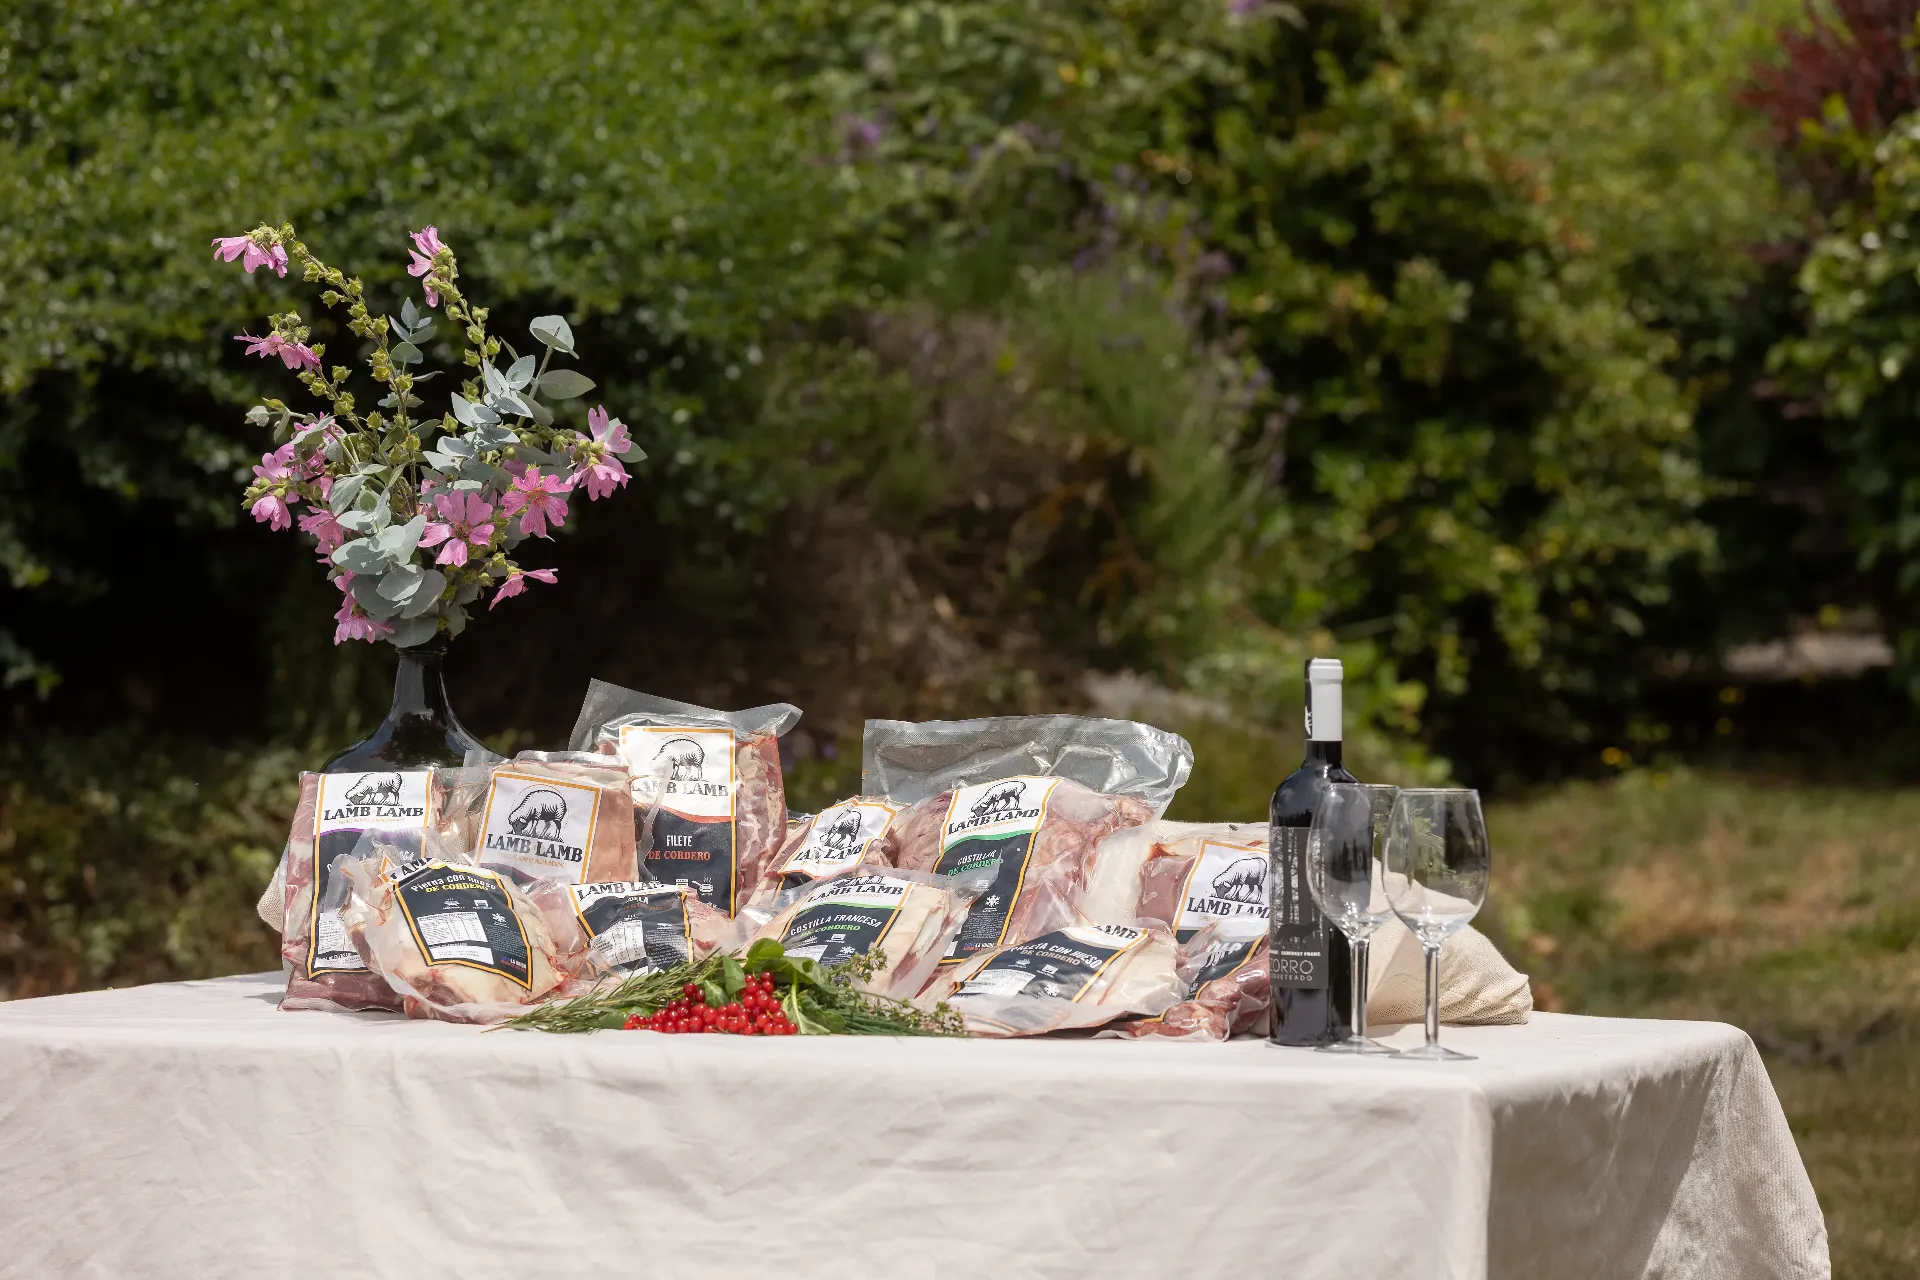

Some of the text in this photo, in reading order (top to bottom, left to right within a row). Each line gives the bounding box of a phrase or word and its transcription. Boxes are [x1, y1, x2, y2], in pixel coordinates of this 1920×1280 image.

[682, 782, 729, 797] LAMB
[324, 806, 371, 821] LAMB
[376, 806, 424, 817] LAMB
[948, 815, 991, 836] LAMB
[993, 808, 1040, 824] LAMB
[486, 833, 531, 854] LAMB
[535, 841, 583, 862] LAMB
[666, 834, 693, 847] FILETE
[648, 850, 711, 861] DE CORDERO
[823, 843, 865, 860] LAMB
[577, 882, 626, 901] LAMB
[807, 887, 852, 902] LAMB
[855, 885, 903, 895] LAMB
[1187, 897, 1269, 919] LAMB LAM
[790, 914, 883, 936] COSTILLA FRANCESA
[1093, 924, 1139, 940] AMB
[1010, 941, 1104, 969] PALETA CON HUESO
[1035, 950, 1081, 966] CORDERO
